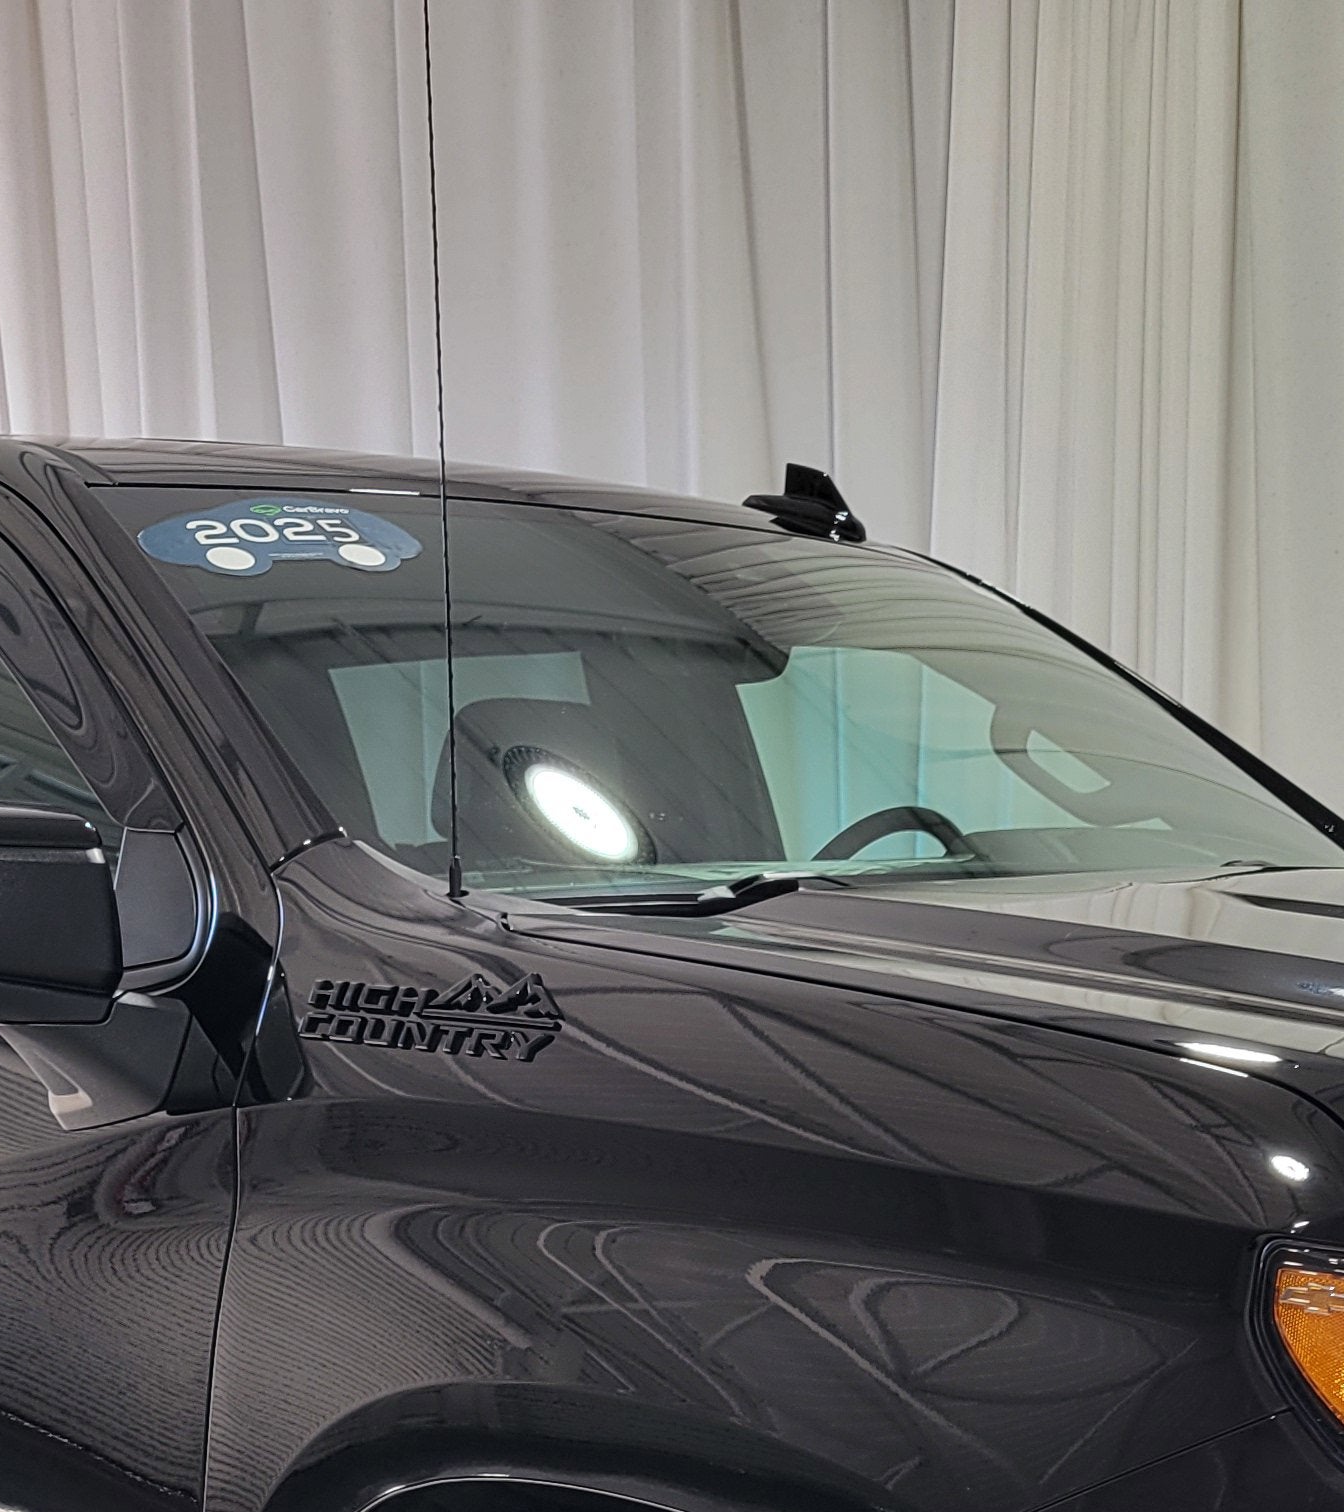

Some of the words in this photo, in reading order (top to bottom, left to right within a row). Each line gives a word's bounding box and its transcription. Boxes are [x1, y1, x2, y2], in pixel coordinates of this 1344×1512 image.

[185, 517, 361, 546] 2025
[308, 979, 439, 1017] HIGH
[298, 1011, 556, 1061] COUNTRY
